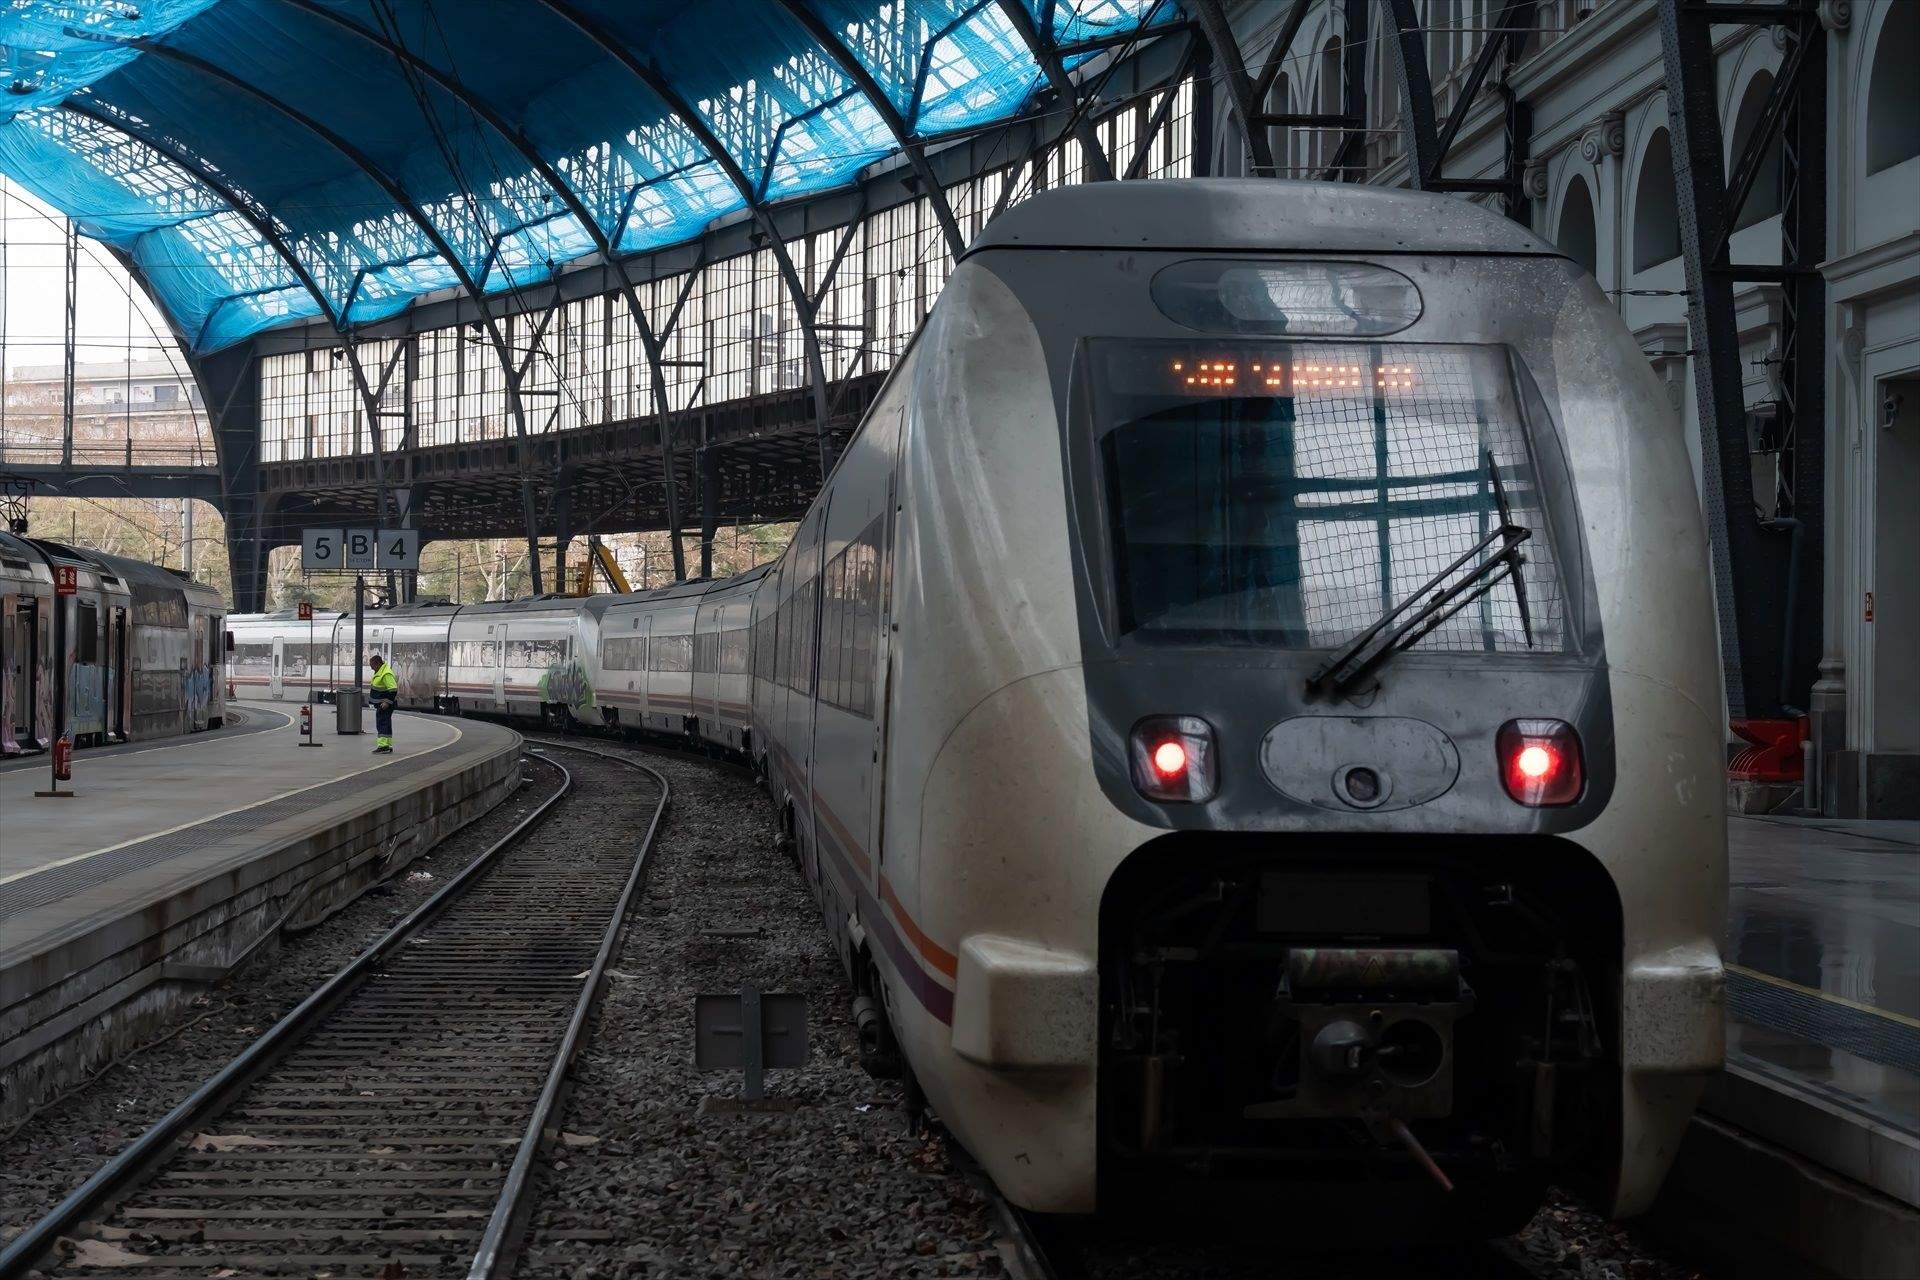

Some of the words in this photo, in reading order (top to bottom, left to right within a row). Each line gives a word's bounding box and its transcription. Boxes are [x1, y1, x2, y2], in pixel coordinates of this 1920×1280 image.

[314, 537, 331, 560] 5
[351, 534, 369, 555] B
[388, 537, 407, 560] 4
